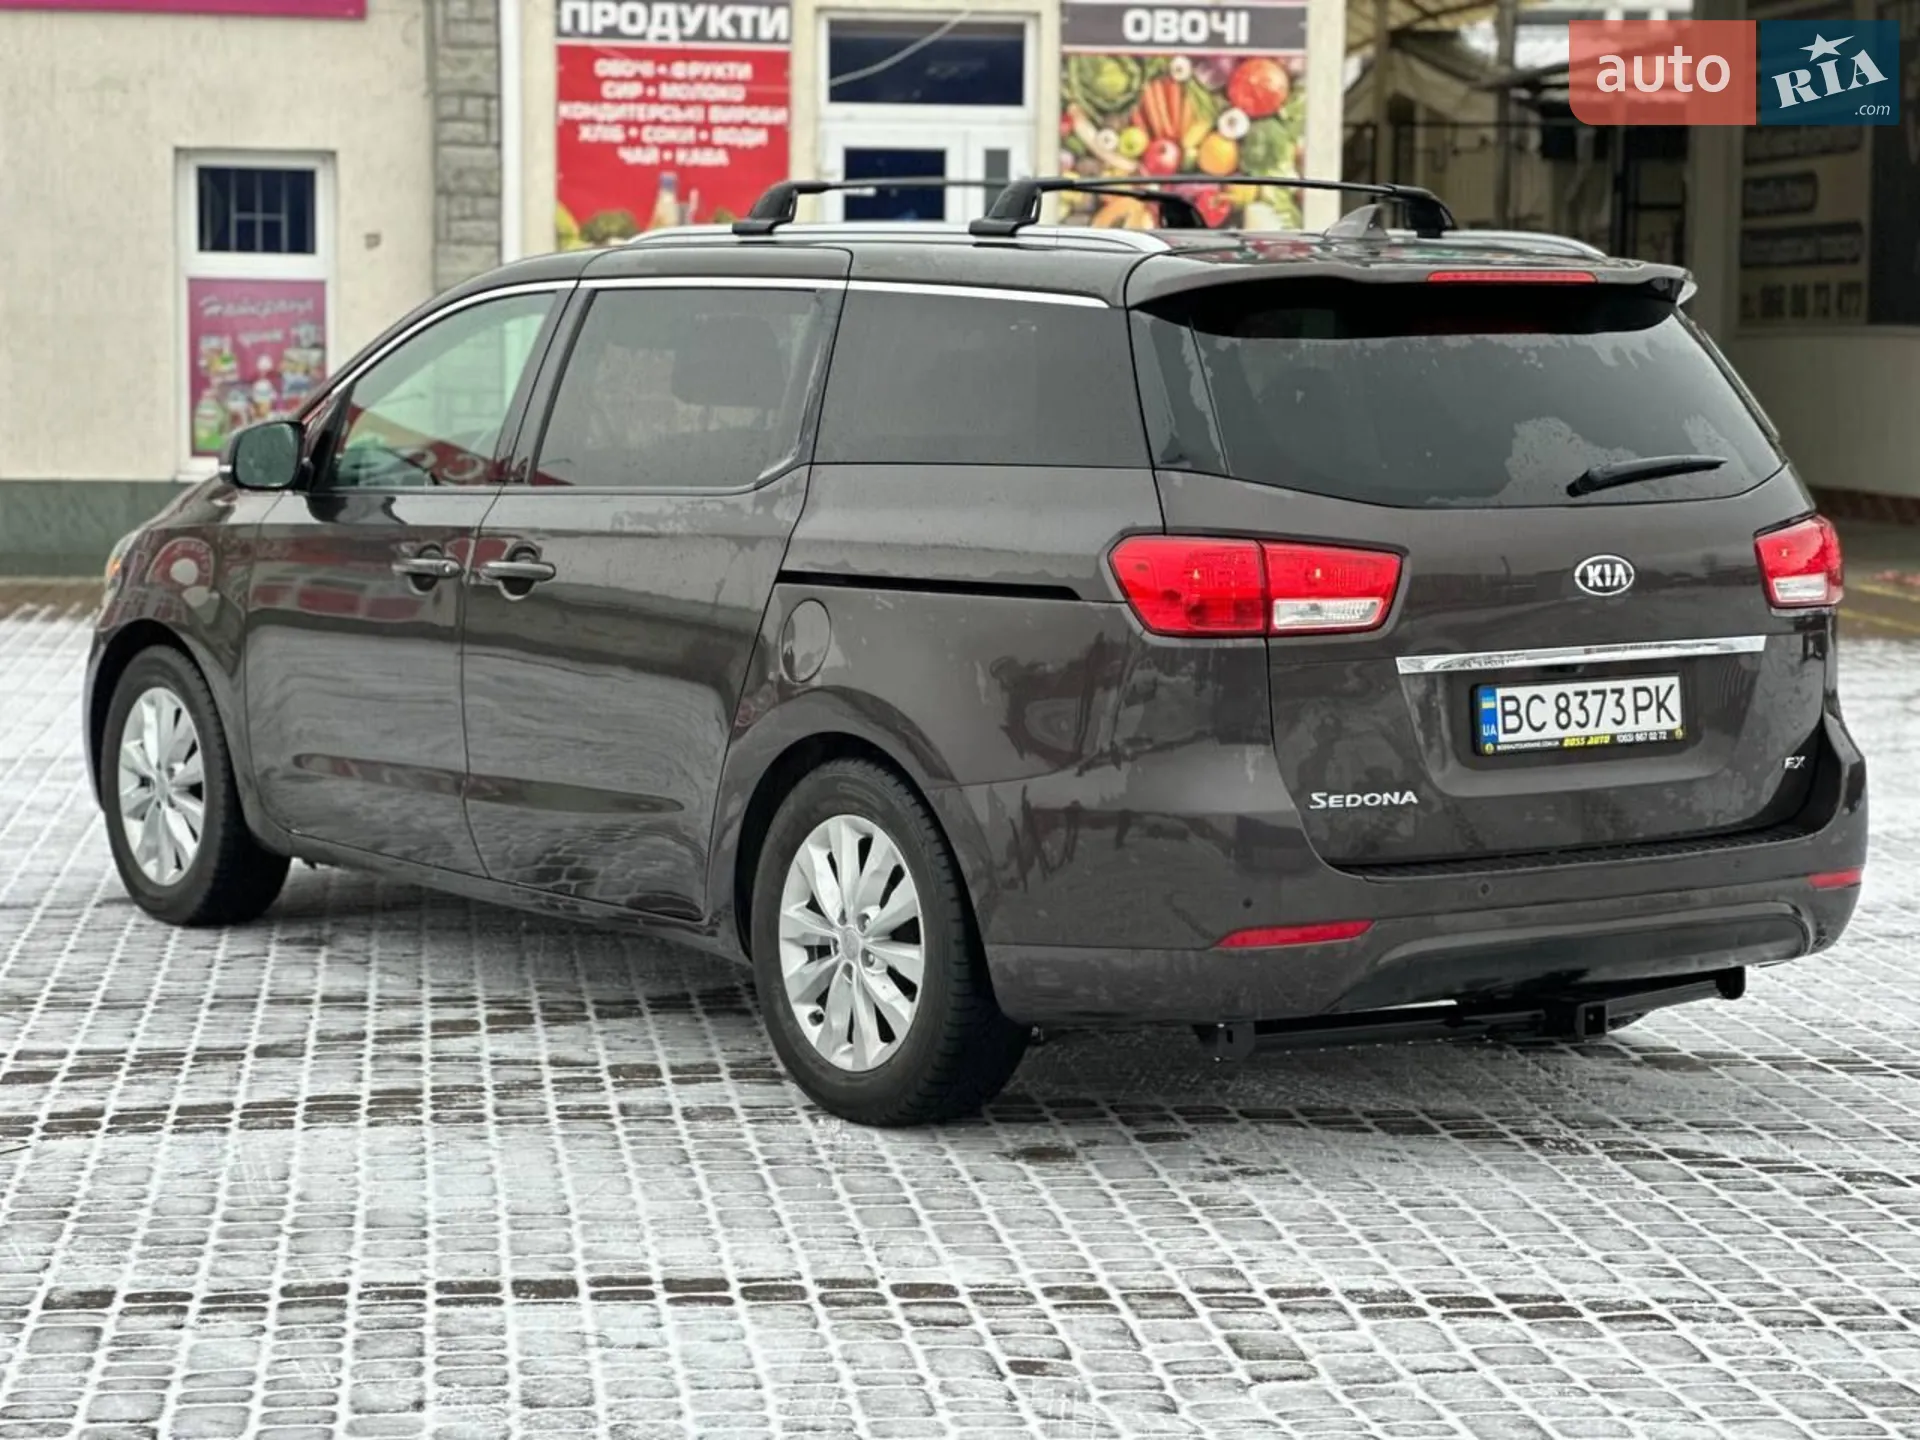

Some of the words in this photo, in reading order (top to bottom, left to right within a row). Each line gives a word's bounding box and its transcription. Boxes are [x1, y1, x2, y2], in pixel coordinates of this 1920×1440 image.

[560, 1, 791, 41] ПРОДУКТИ
[1123, 8, 1250, 44] ОВОЧІ
[1586, 563, 1627, 587] KIA
[1501, 694, 1547, 735] BC
[1554, 687, 1626, 730] 8373
[1633, 683, 1676, 725] PK
[1482, 724, 1498, 736] UA
[1309, 790, 1419, 809] SEDONA
